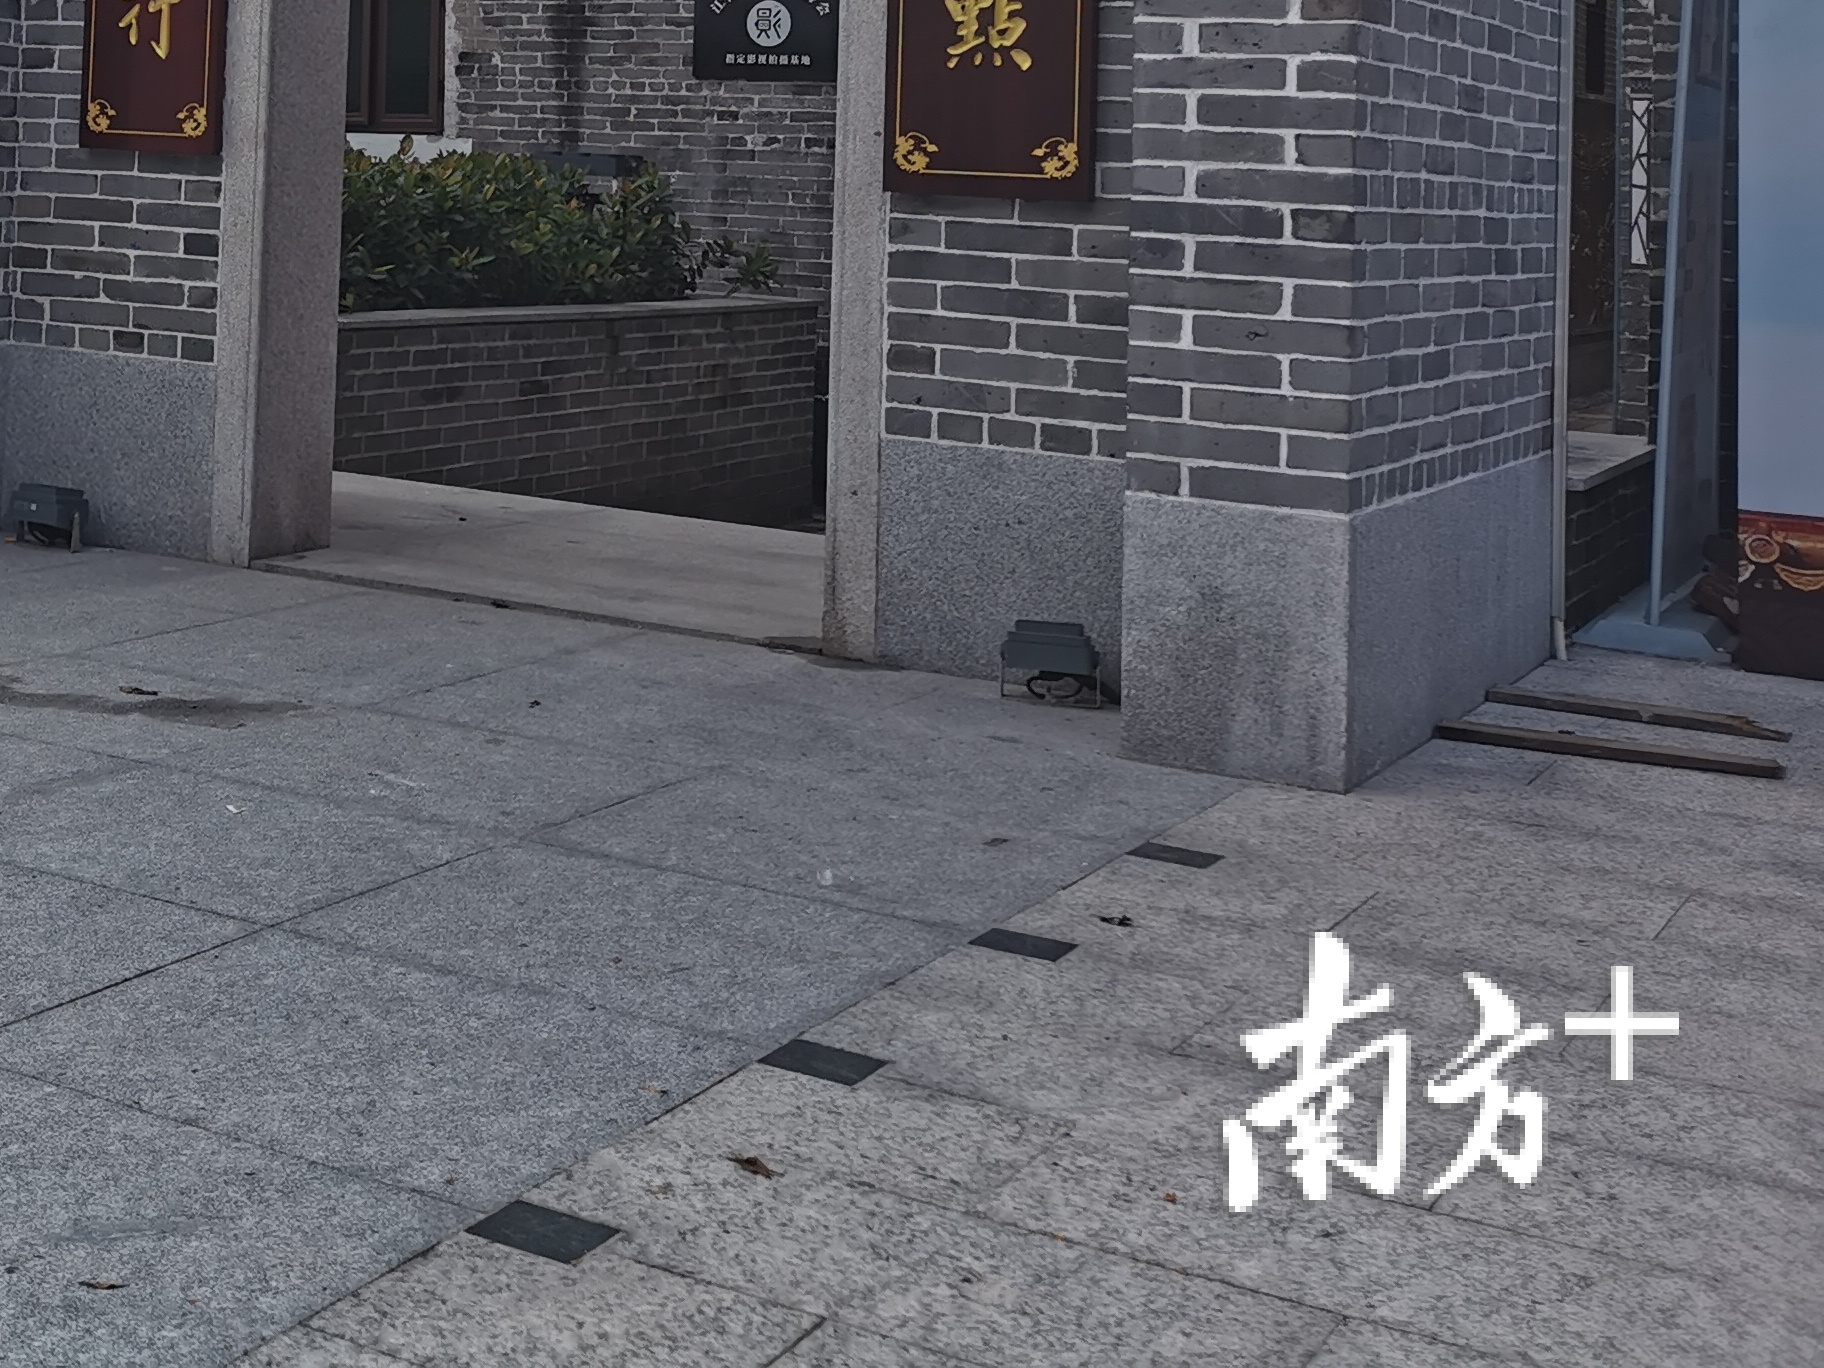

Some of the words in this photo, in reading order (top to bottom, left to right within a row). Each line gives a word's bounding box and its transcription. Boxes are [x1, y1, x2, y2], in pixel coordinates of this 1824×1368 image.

[725, 53, 811, 66] 指定影视拍摄基地
